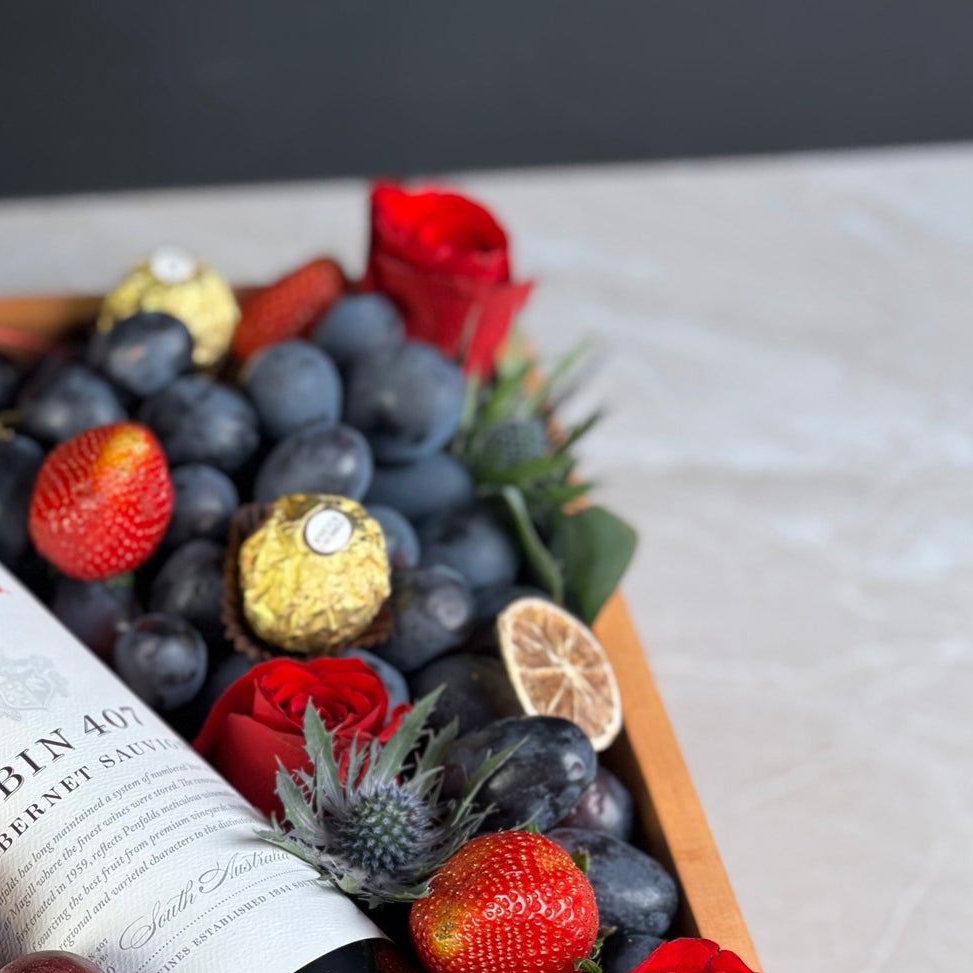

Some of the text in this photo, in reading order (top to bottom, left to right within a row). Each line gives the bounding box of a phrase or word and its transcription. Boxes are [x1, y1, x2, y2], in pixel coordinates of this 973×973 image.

[83, 706, 144, 737] 407
[10, 881, 37, 920] Magill
[36, 859, 64, 887] where
[62, 844, 78, 860] the
[77, 824, 103, 852] finest
[102, 806, 130, 826] wines
[130, 794, 154, 809] were
[15, 925, 30, 954] first
[31, 893, 57, 929] created
[56, 884, 67, 895] in
[67, 859, 93, 884] 1959,
[92, 834, 123, 863] reflects
[122, 808, 160, 836] Penfolds
[18, 860, 34, 880] has
[31, 843, 55, 863] long
[53, 797, 105, 845] maintained
[105, 794, 113, 803] a
[112, 780, 141, 801] system
[141, 771, 151, 786] of
[36, 908, 72, 949] sourcing
[68, 895, 84, 911] the
[83, 875, 101, 895] best
[101, 858, 125, 882] fruit
[124, 839, 149, 863] from
[149, 816, 190, 846] premium
[59, 910, 92, 951] regional
[93, 891, 112, 915] and
[111, 861, 149, 896] varietal
[149, 835, 195, 866] characters
[194, 830, 204, 841] to
[203, 824, 218, 835] the
[119, 848, 290, 951] South Australia
[191, 895, 267, 947] ESTABLISHED
[268, 884, 292, 898] 1844
